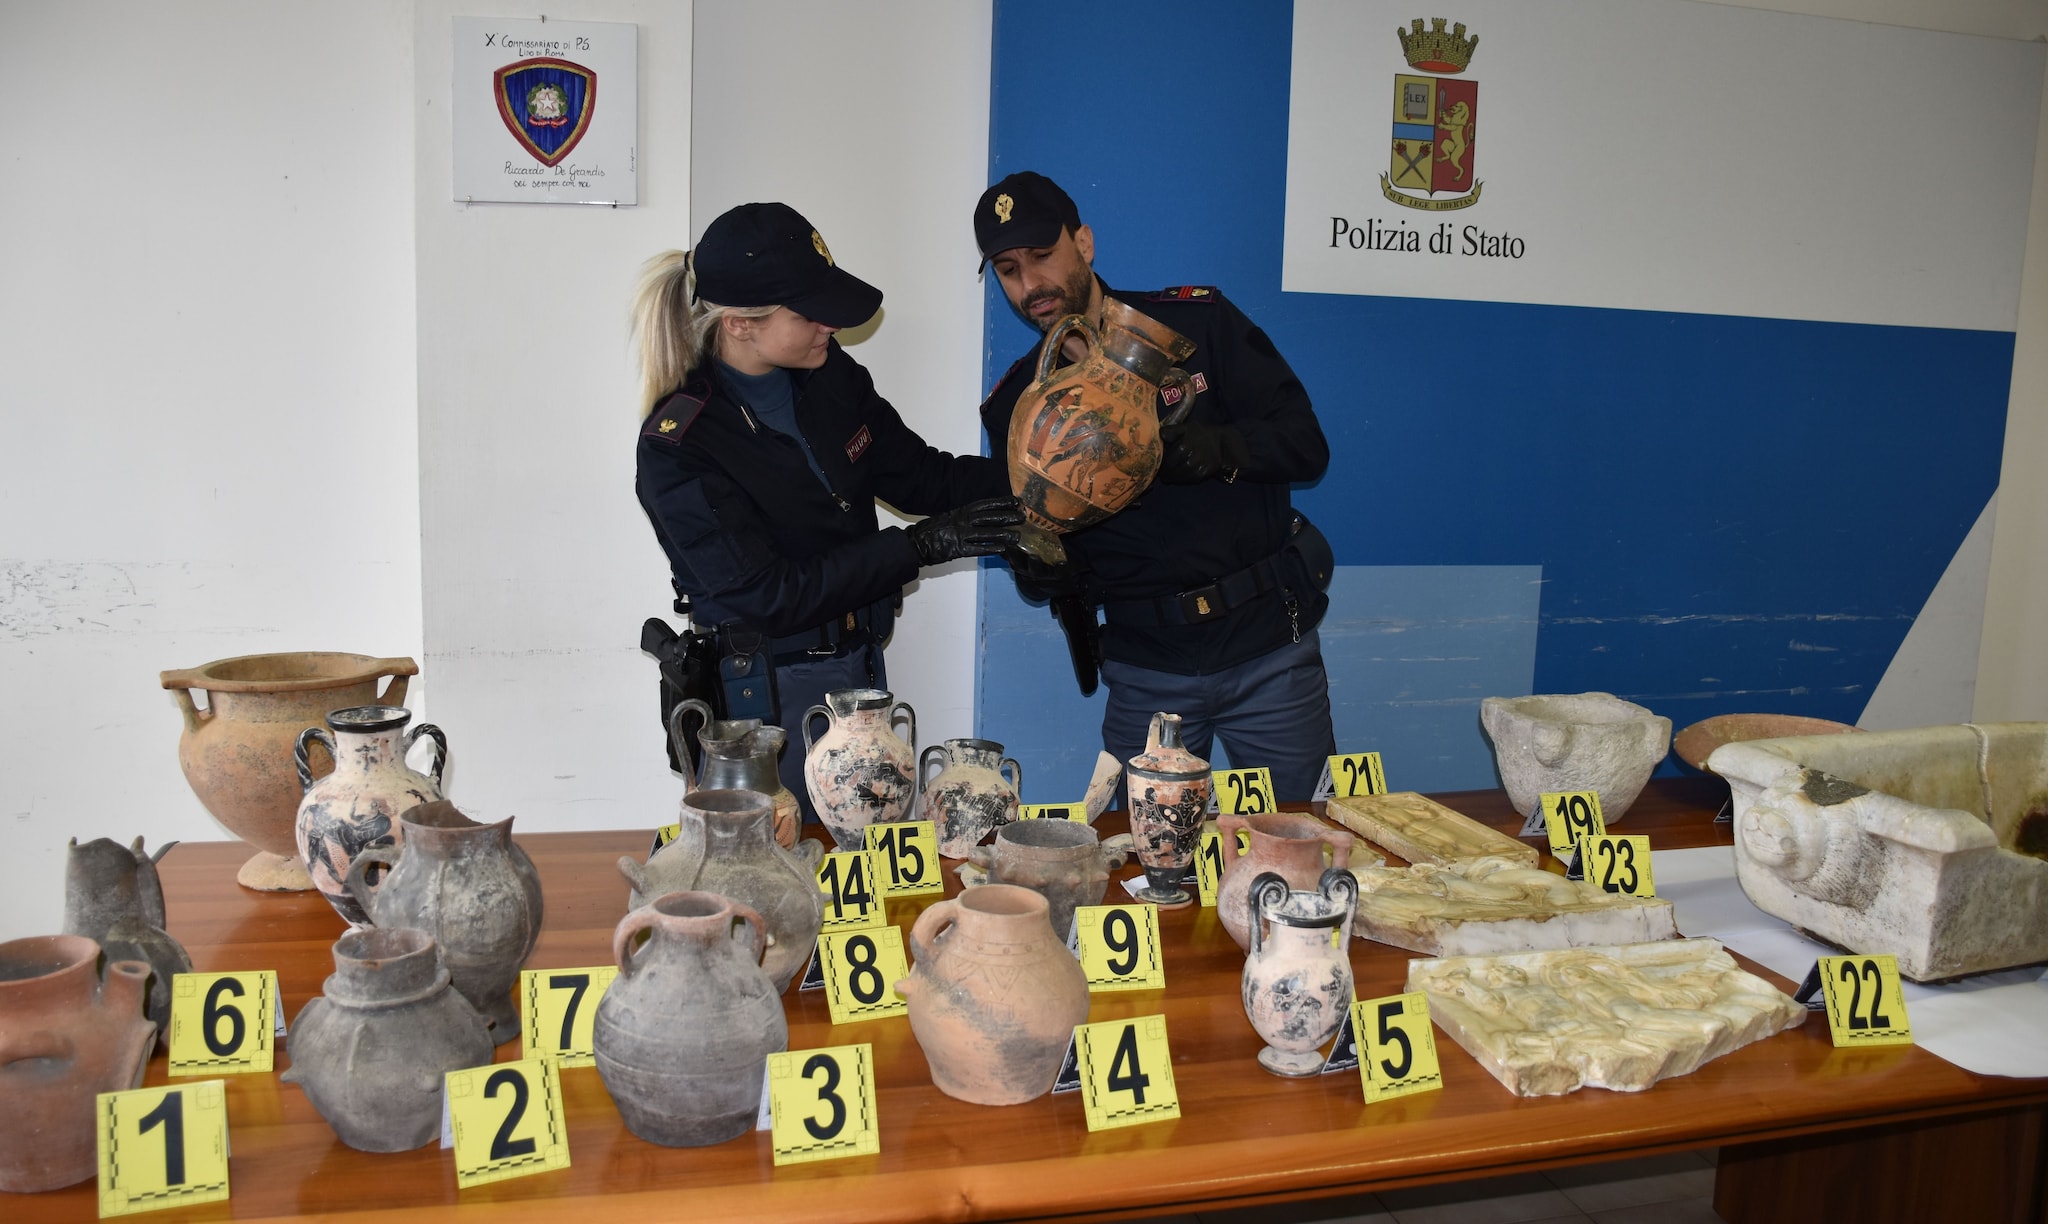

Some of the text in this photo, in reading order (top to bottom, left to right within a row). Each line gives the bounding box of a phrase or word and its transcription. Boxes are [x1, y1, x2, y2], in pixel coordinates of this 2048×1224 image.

[1409, 93, 1427, 103] LEX
[504, 160, 606, 181] Riccardo De Grandis
[1409, 199, 1431, 209] LEGE
[1435, 198, 1473, 210] LIBERTAS
[1329, 217, 1526, 259] Polizia di Stato
[1228, 772, 1266, 815] 25
[1342, 757, 1375, 798] 21
[1555, 795, 1594, 846] 19
[820, 855, 871, 919] 14
[878, 827, 925, 884] 15
[1598, 839, 1639, 894] 23
[844, 935, 885, 1005] 8
[1103, 909, 1139, 976] 9
[202, 977, 246, 1057] 6
[549, 974, 590, 1050] 7
[1840, 960, 1891, 1030] 22
[1107, 1024, 1150, 1105] 4
[1378, 1001, 1413, 1080] 5
[483, 1068, 536, 1161] 2
[801, 1053, 847, 1141] 3
[138, 1091, 186, 1187] 1
